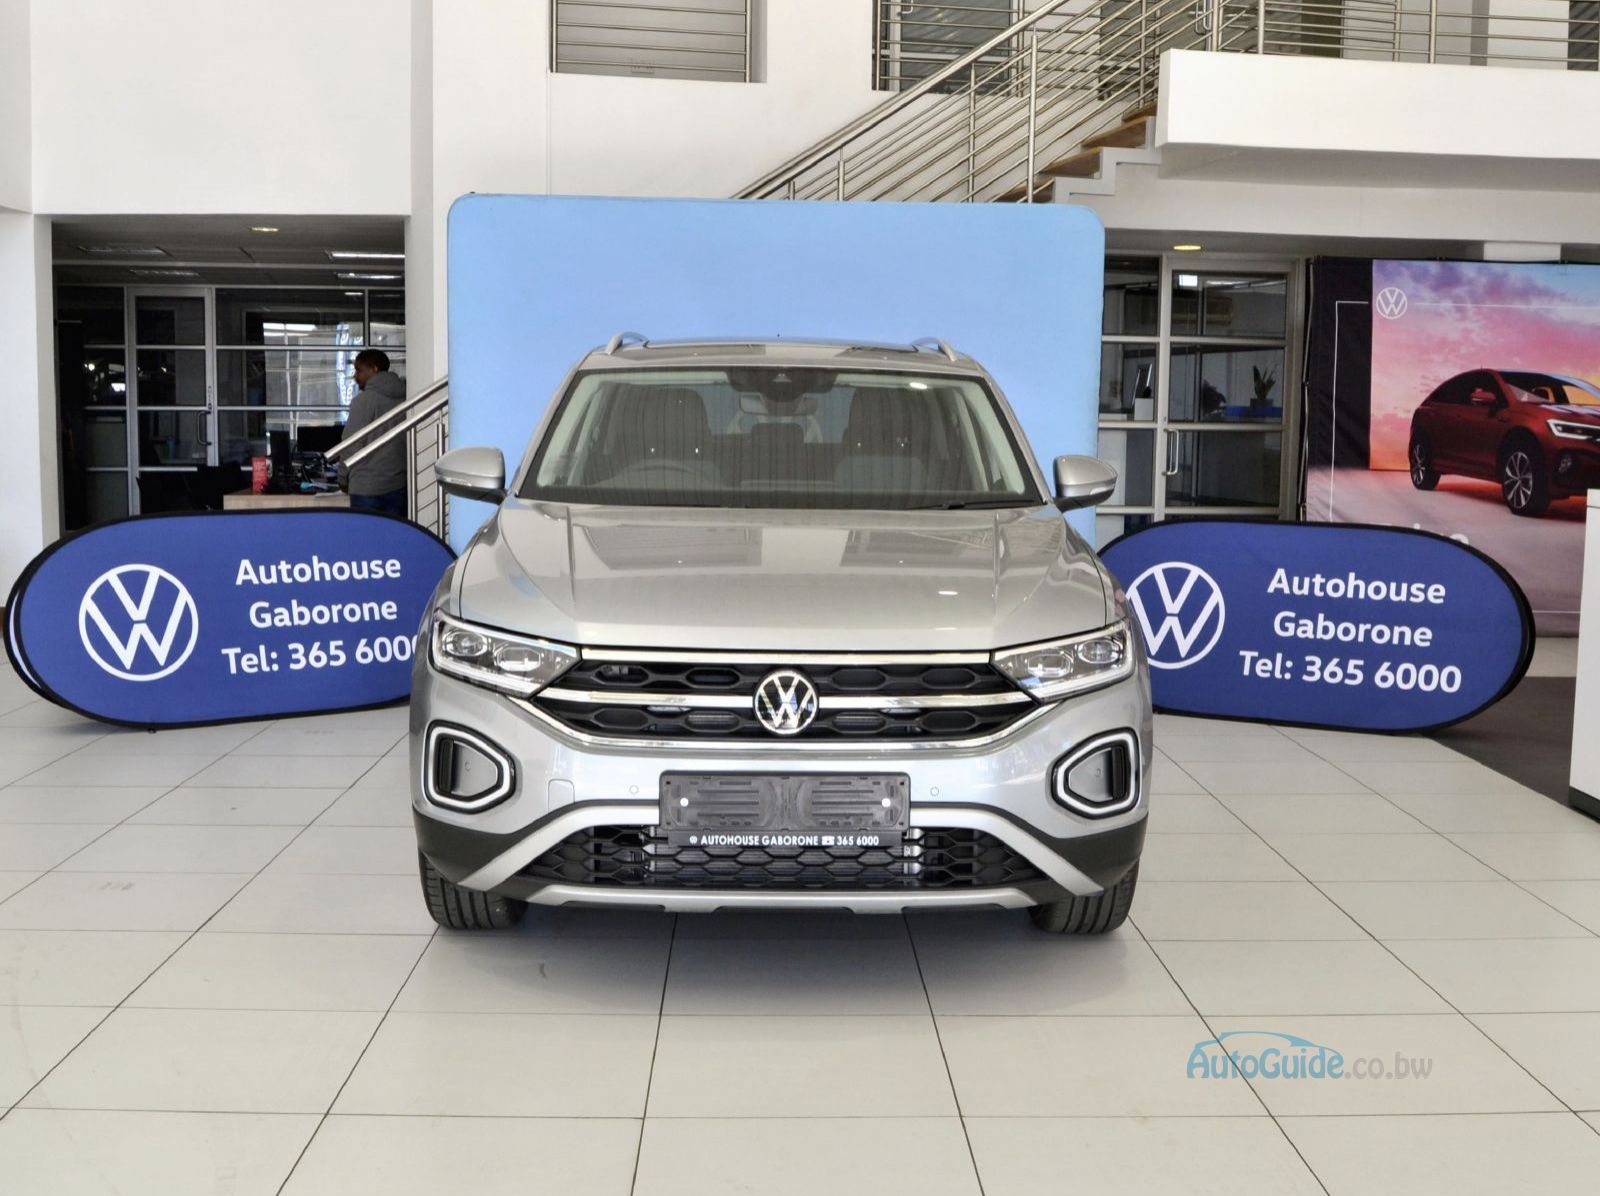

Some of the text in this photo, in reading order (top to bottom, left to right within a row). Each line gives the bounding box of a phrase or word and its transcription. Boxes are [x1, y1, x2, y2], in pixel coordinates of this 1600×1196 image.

[235, 555, 401, 586] Autohouse
[1267, 568, 1446, 604] Autohouse
[249, 599, 398, 629] Gaborone
[1273, 610, 1433, 647] Gaborone
[221, 634, 418, 674] Tel: 365 600
[1239, 650, 1462, 693] Tel: 365 6000
[700, 834, 760, 846] AUTOHOUSE
[761, 834, 819, 846] GABORONE
[836, 834, 854, 846] 365
[856, 835, 880, 846] 6000
